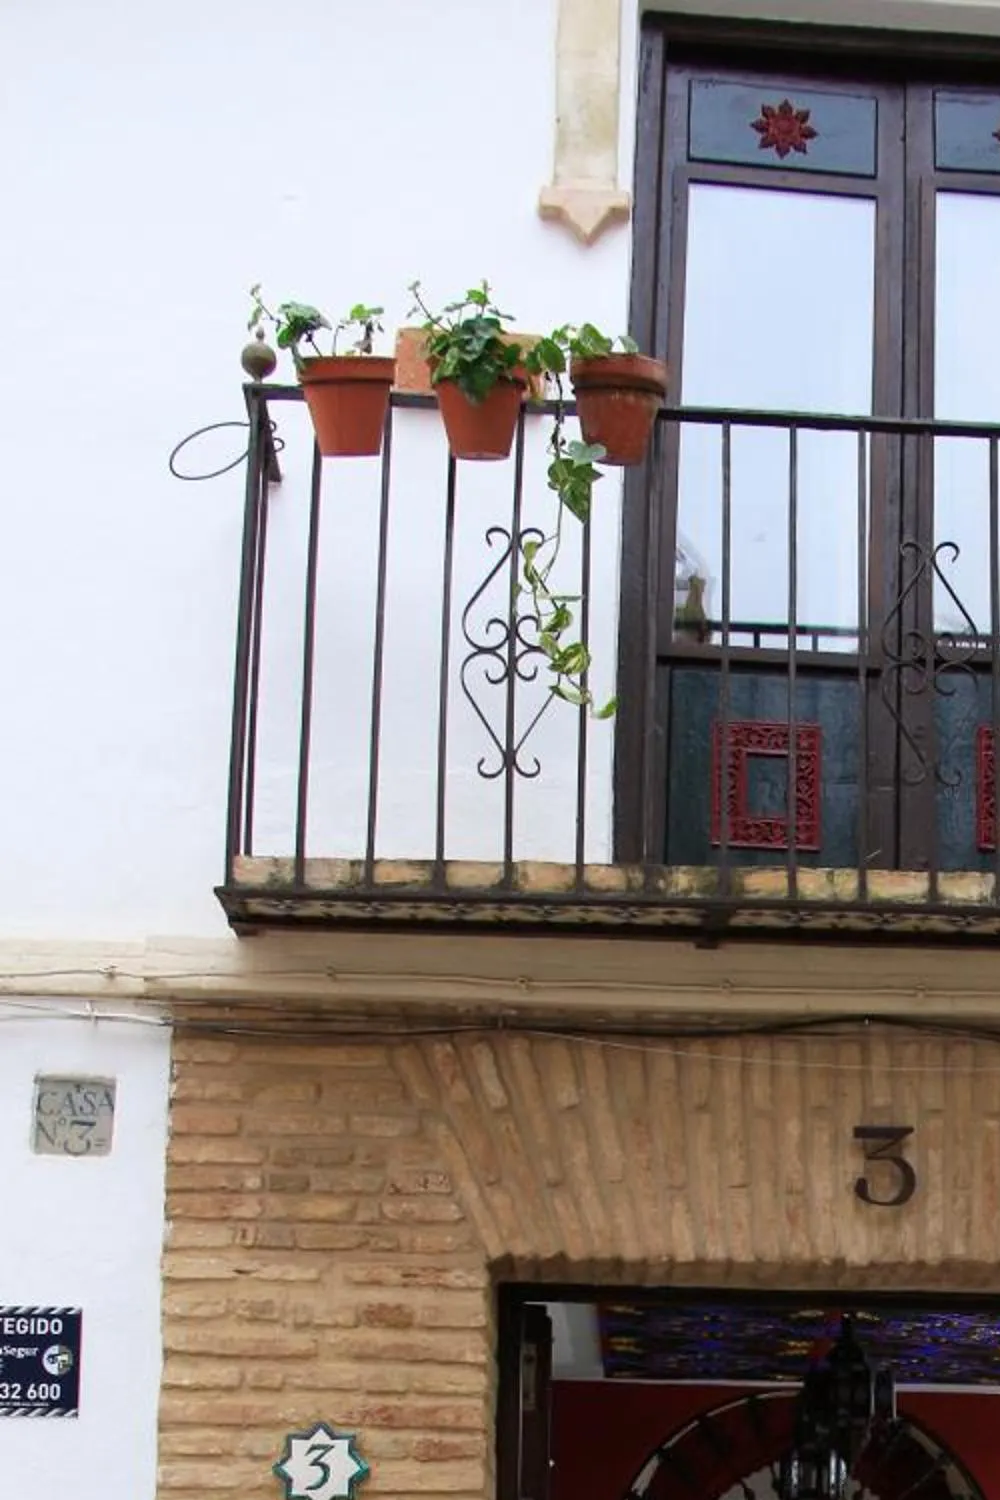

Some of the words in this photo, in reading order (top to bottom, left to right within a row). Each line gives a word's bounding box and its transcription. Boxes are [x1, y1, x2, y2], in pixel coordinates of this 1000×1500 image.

[37, 1089, 114, 1116] CASA
[853, 1126, 916, 1206] 3
[27, 1382, 61, 1400] 600
[304, 1443, 336, 1491] 3
